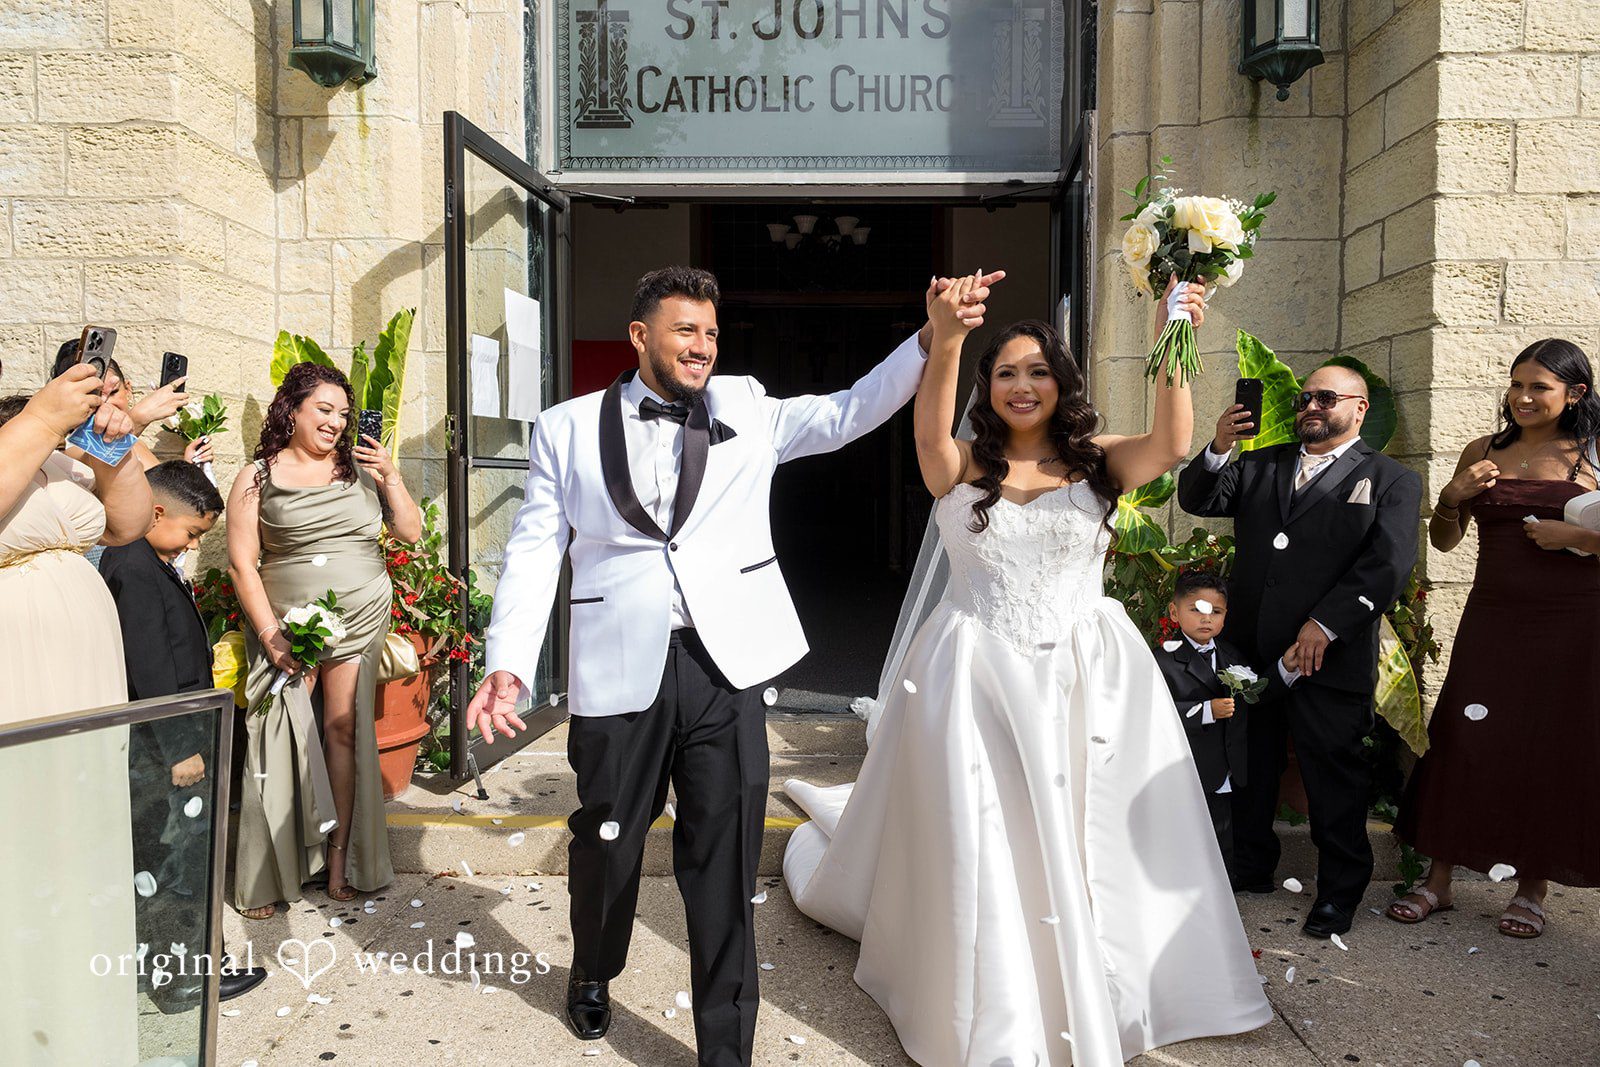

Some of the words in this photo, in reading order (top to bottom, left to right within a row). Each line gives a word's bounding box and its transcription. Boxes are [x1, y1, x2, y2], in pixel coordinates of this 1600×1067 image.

[665, 0, 737, 40] ST.
[752, 0, 951, 40] JOHNS
[637, 65, 815, 113] CATHOLIC
[830, 64, 980, 113] CHURC
